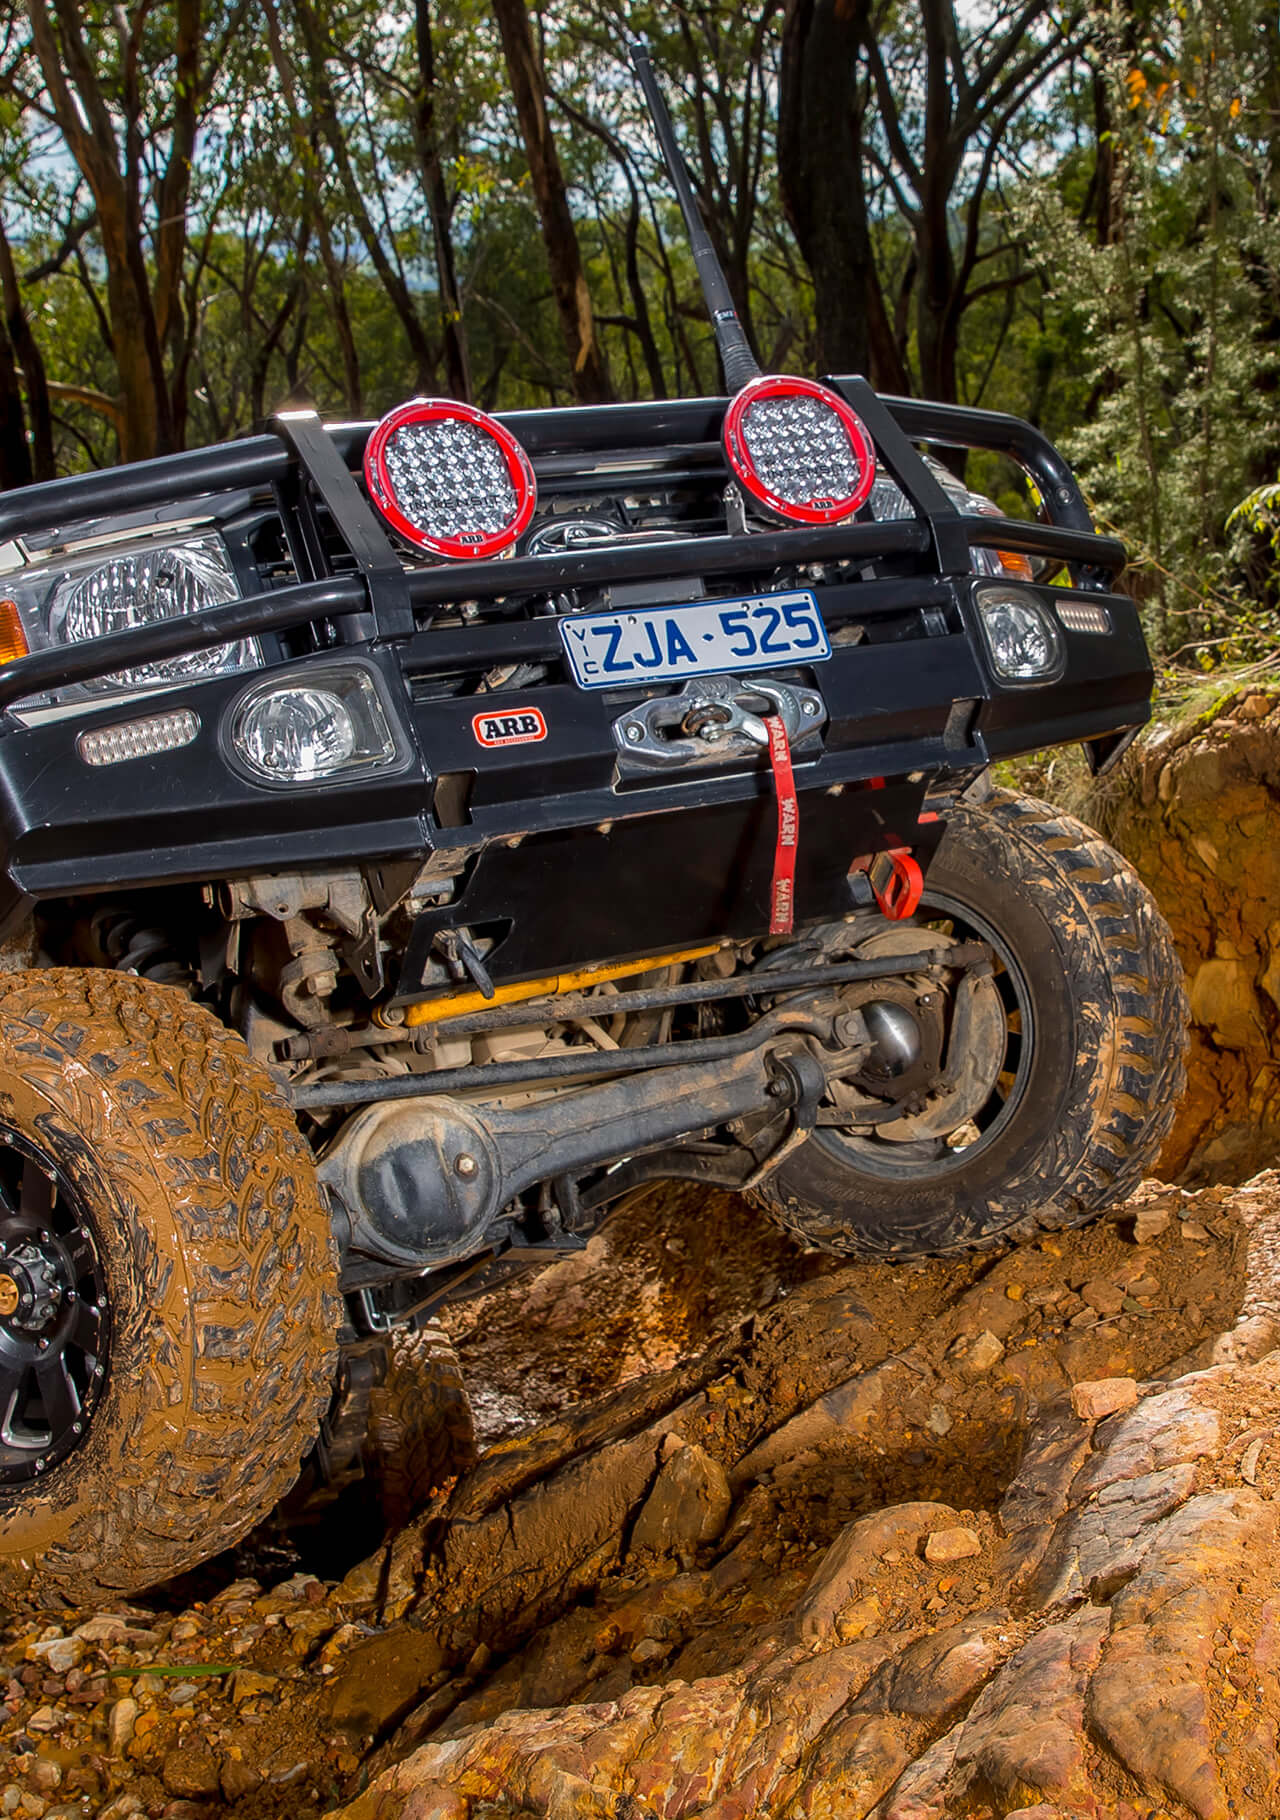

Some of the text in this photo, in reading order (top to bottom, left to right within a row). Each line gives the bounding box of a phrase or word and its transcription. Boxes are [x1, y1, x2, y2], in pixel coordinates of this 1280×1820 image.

[409, 493, 513, 512] INTENSITY
[813, 500, 834, 510] ARB
[461, 534, 483, 544] ARB
[572, 628, 599, 674] VIC
[591, 602, 820, 673] ZJA 525
[484, 715, 539, 740] ARB
[767, 715, 788, 762] WARN
[780, 797, 795, 846] WARN
[775, 878, 791, 923] WARN
